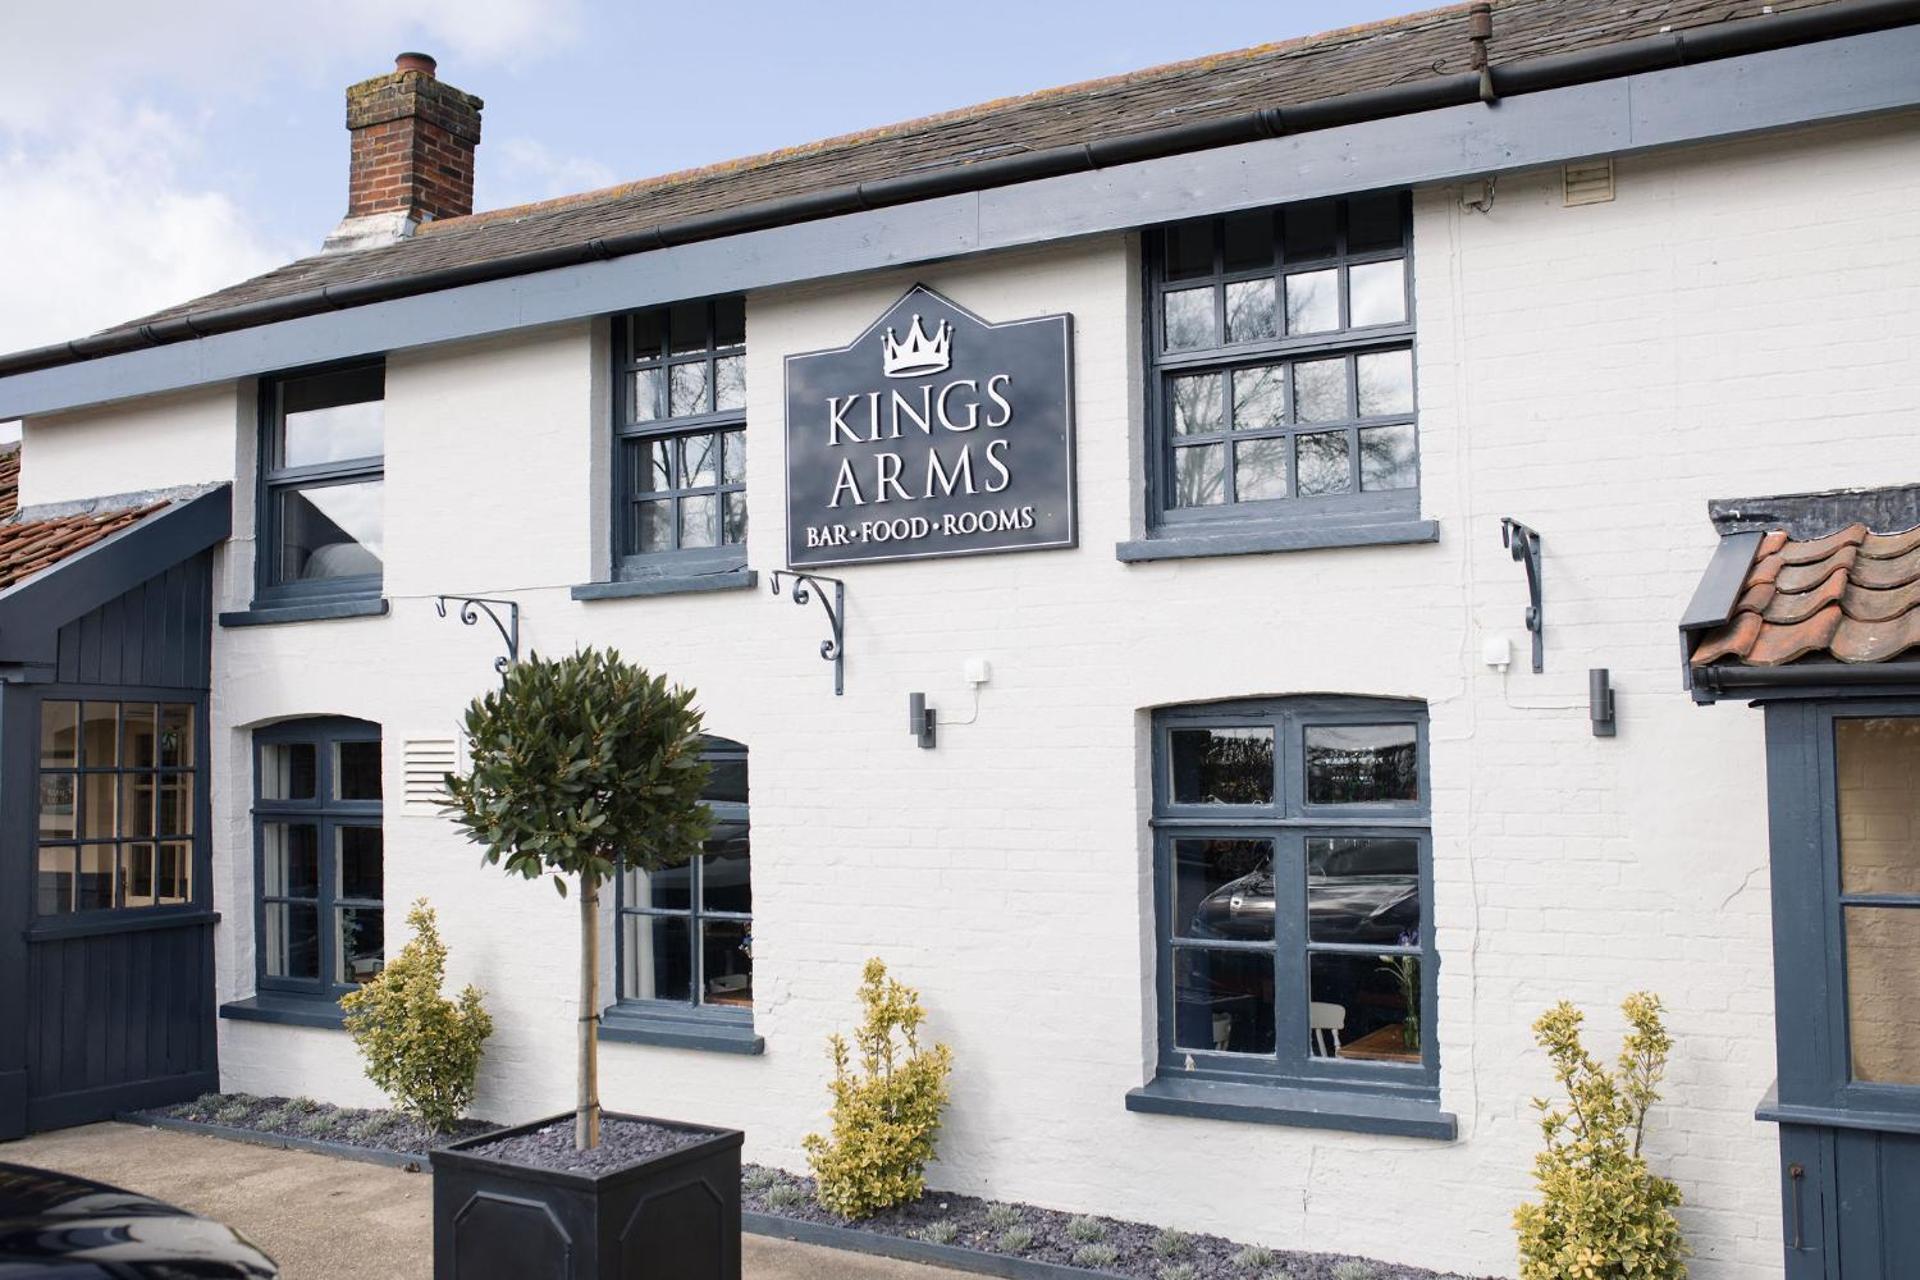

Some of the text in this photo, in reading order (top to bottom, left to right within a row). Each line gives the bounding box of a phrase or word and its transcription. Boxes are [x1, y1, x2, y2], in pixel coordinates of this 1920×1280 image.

[826, 374, 1011, 446] KINGS
[826, 439, 1010, 508] ARMS
[807, 506, 1033, 548] BAR FOOD ROOMS
